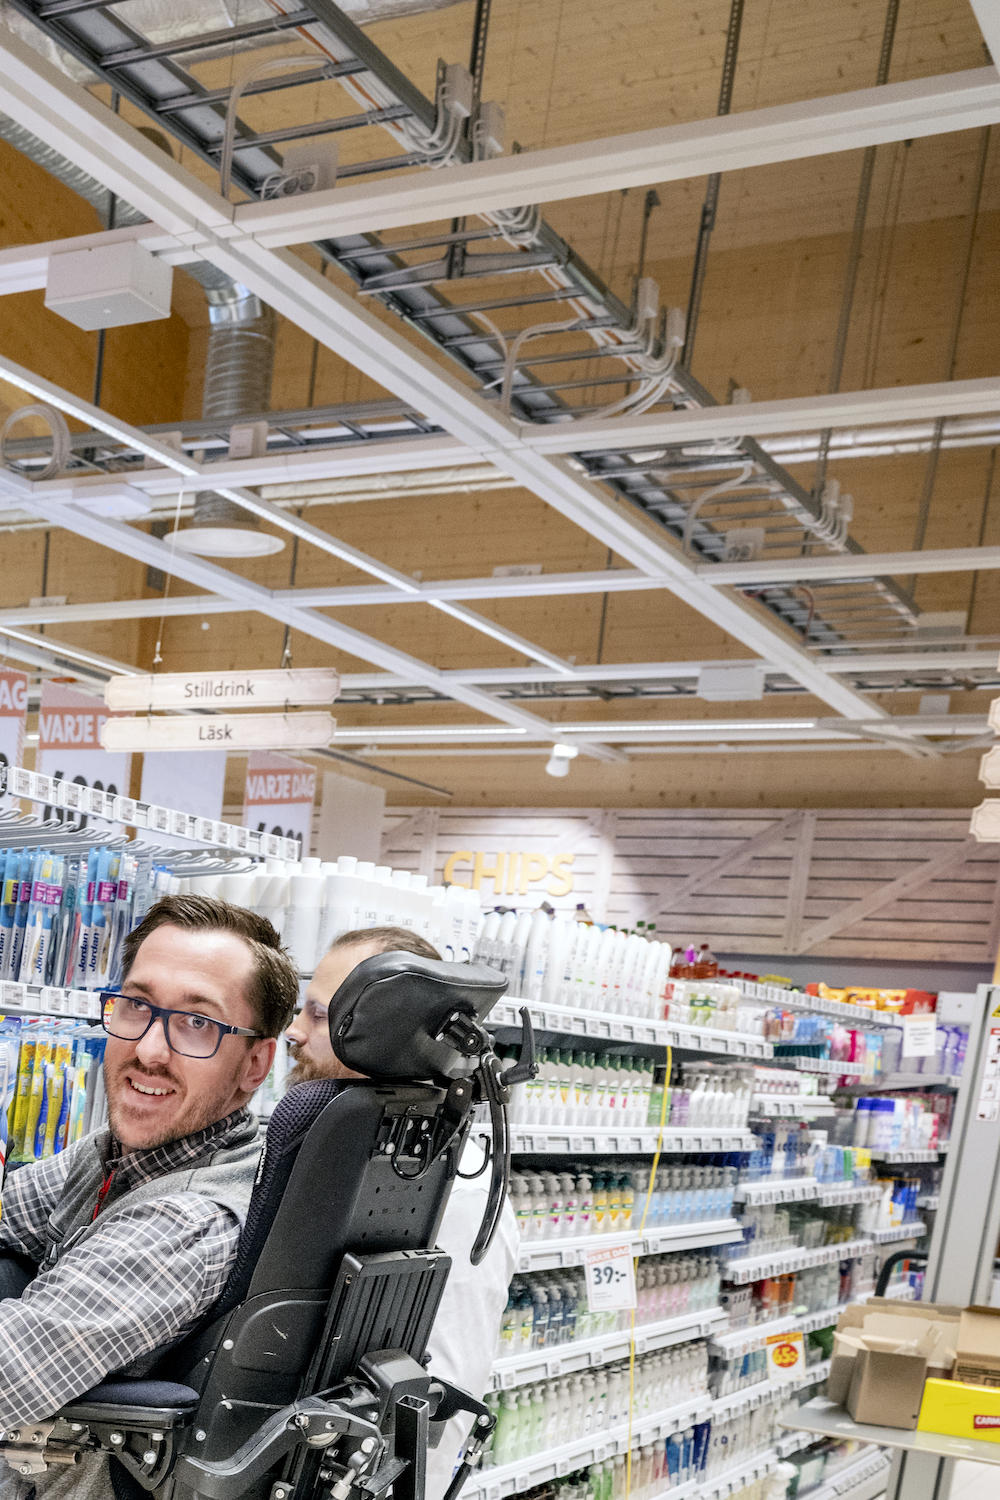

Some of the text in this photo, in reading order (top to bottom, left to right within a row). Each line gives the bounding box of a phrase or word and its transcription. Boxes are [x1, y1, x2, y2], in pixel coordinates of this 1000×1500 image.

[184, 682, 255, 698] Stilldrink
[39, 712, 93, 744] VARJE
[198, 724, 233, 741] Läsk
[246, 773, 315, 800] VARJE DAG
[444, 850, 575, 897] CHIPS
[79, 933, 89, 972] Jordan
[90, 932, 99, 972] Jordan
